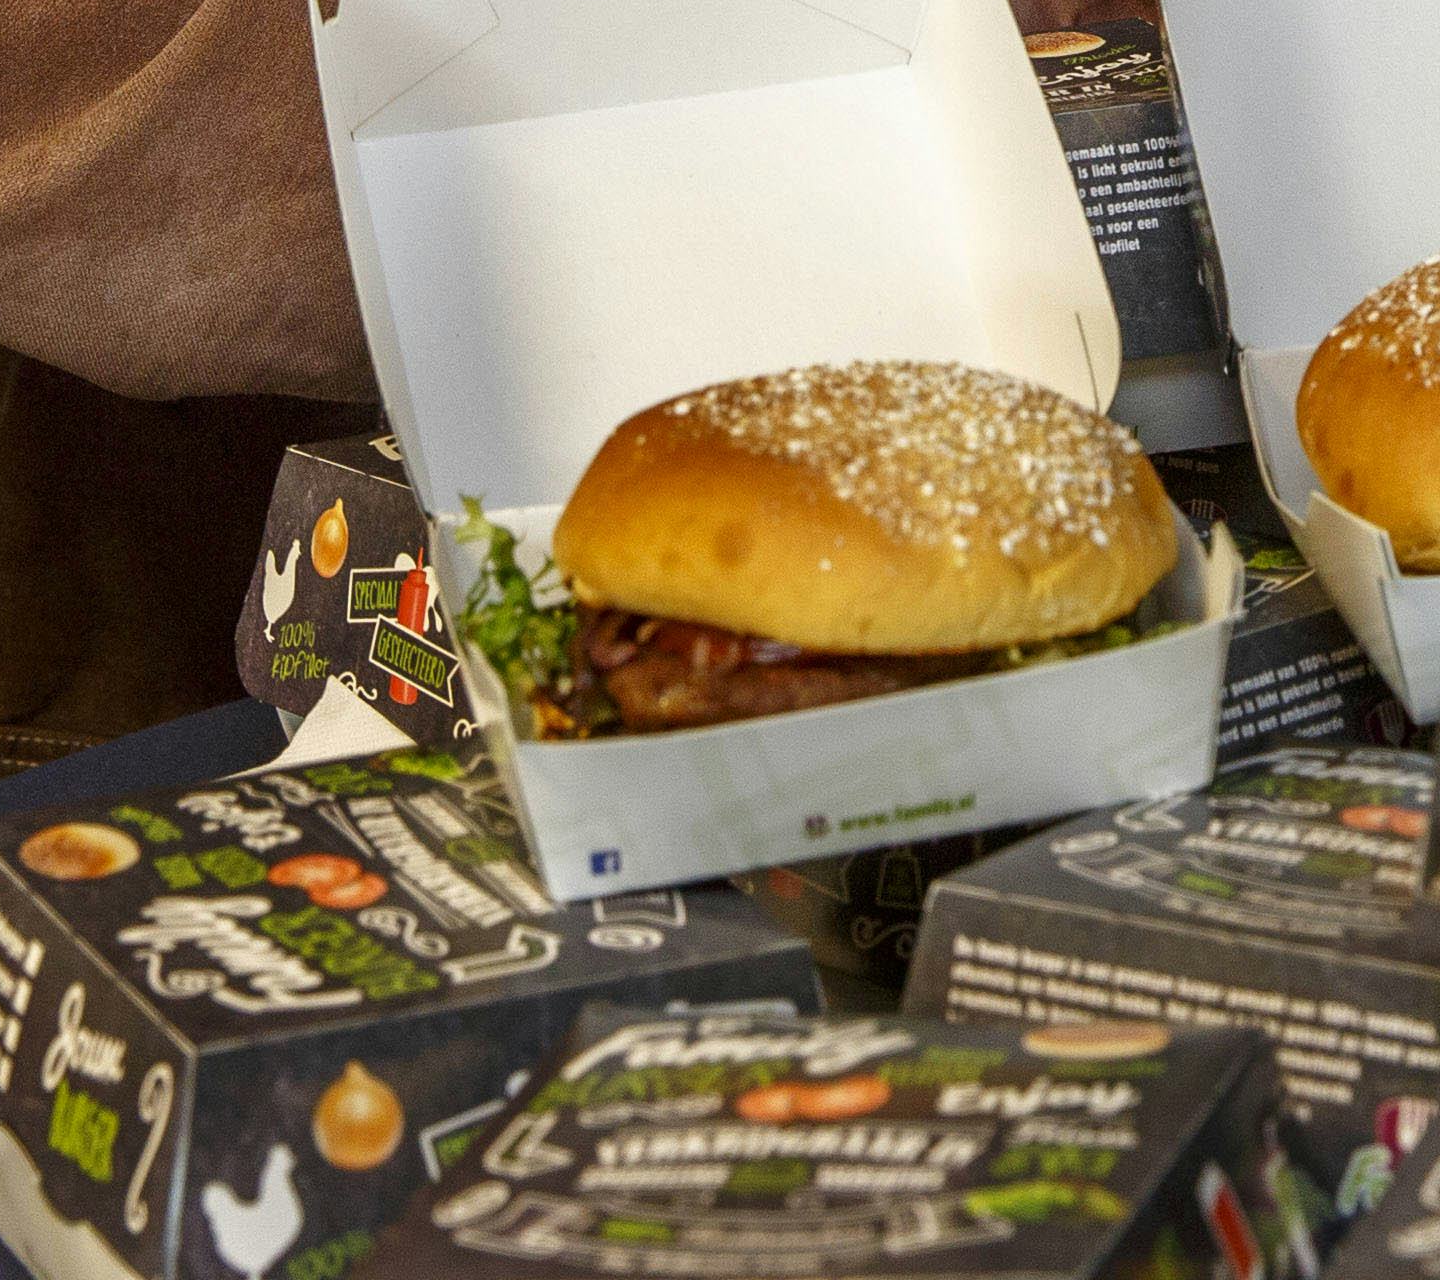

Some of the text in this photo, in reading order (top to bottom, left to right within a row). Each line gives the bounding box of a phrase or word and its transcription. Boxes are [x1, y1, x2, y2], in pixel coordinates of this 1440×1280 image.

[1118, 142, 1140, 155] van
[1092, 163, 1117, 178] licht
[1120, 157, 1164, 175] gekruid
[1091, 186, 1113, 198] een
[1116, 173, 1190, 193] ambachtelij
[1107, 220, 1133, 234] voor
[1137, 217, 1160, 230] een
[1099, 238, 1141, 255] kipfilet
[278, 621, 316, 649] 100%
